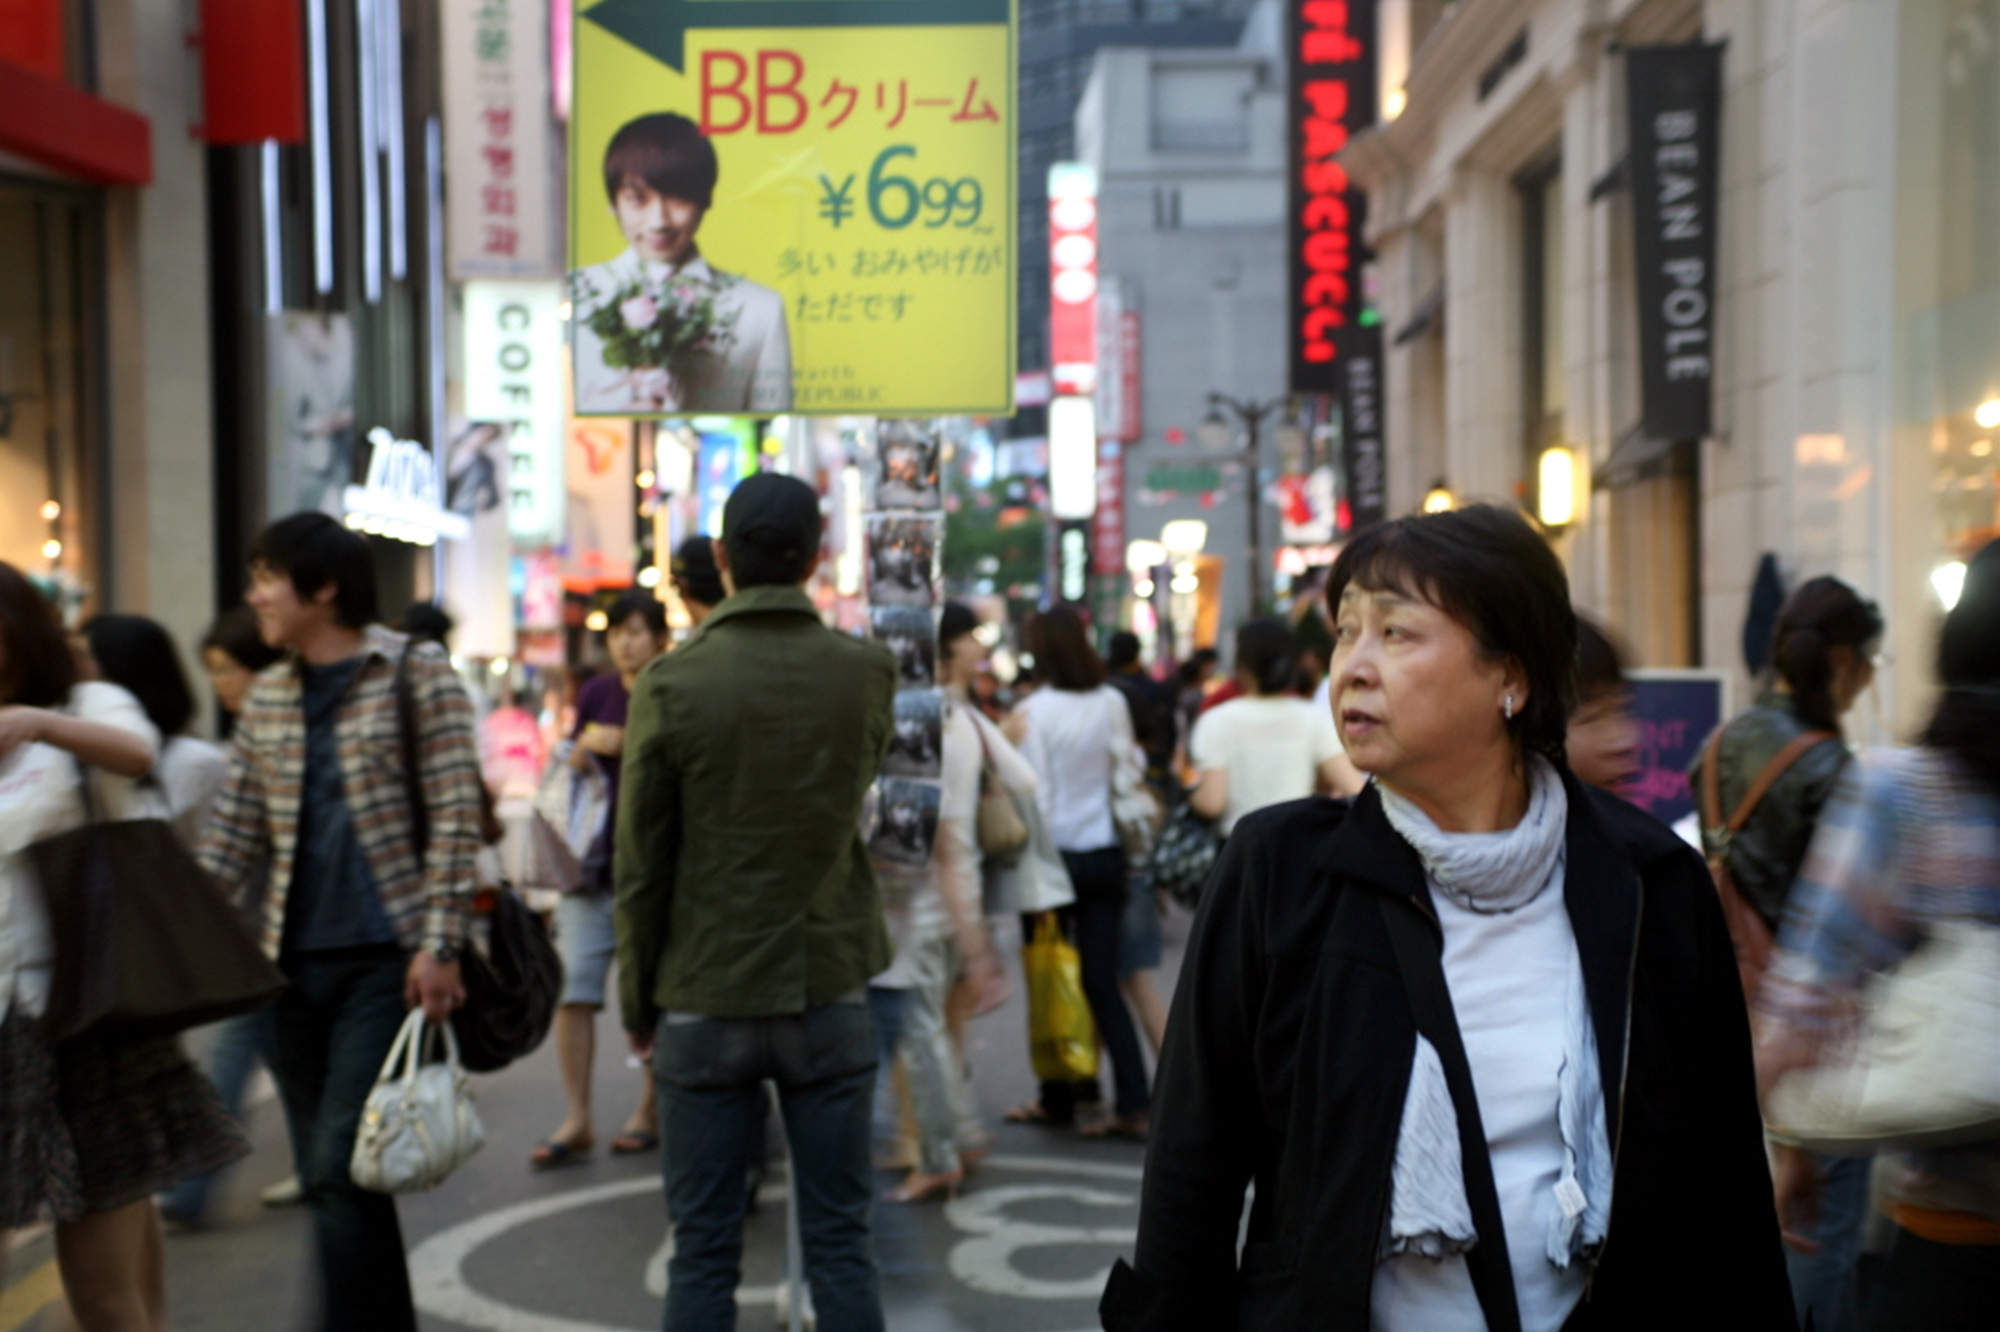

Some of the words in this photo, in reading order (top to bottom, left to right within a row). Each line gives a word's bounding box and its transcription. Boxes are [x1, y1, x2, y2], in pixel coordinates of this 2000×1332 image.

[1655, 109, 1698, 241] BEAN
[1662, 257, 1710, 381] POLE
[1346, 357, 1376, 433] BEAN
